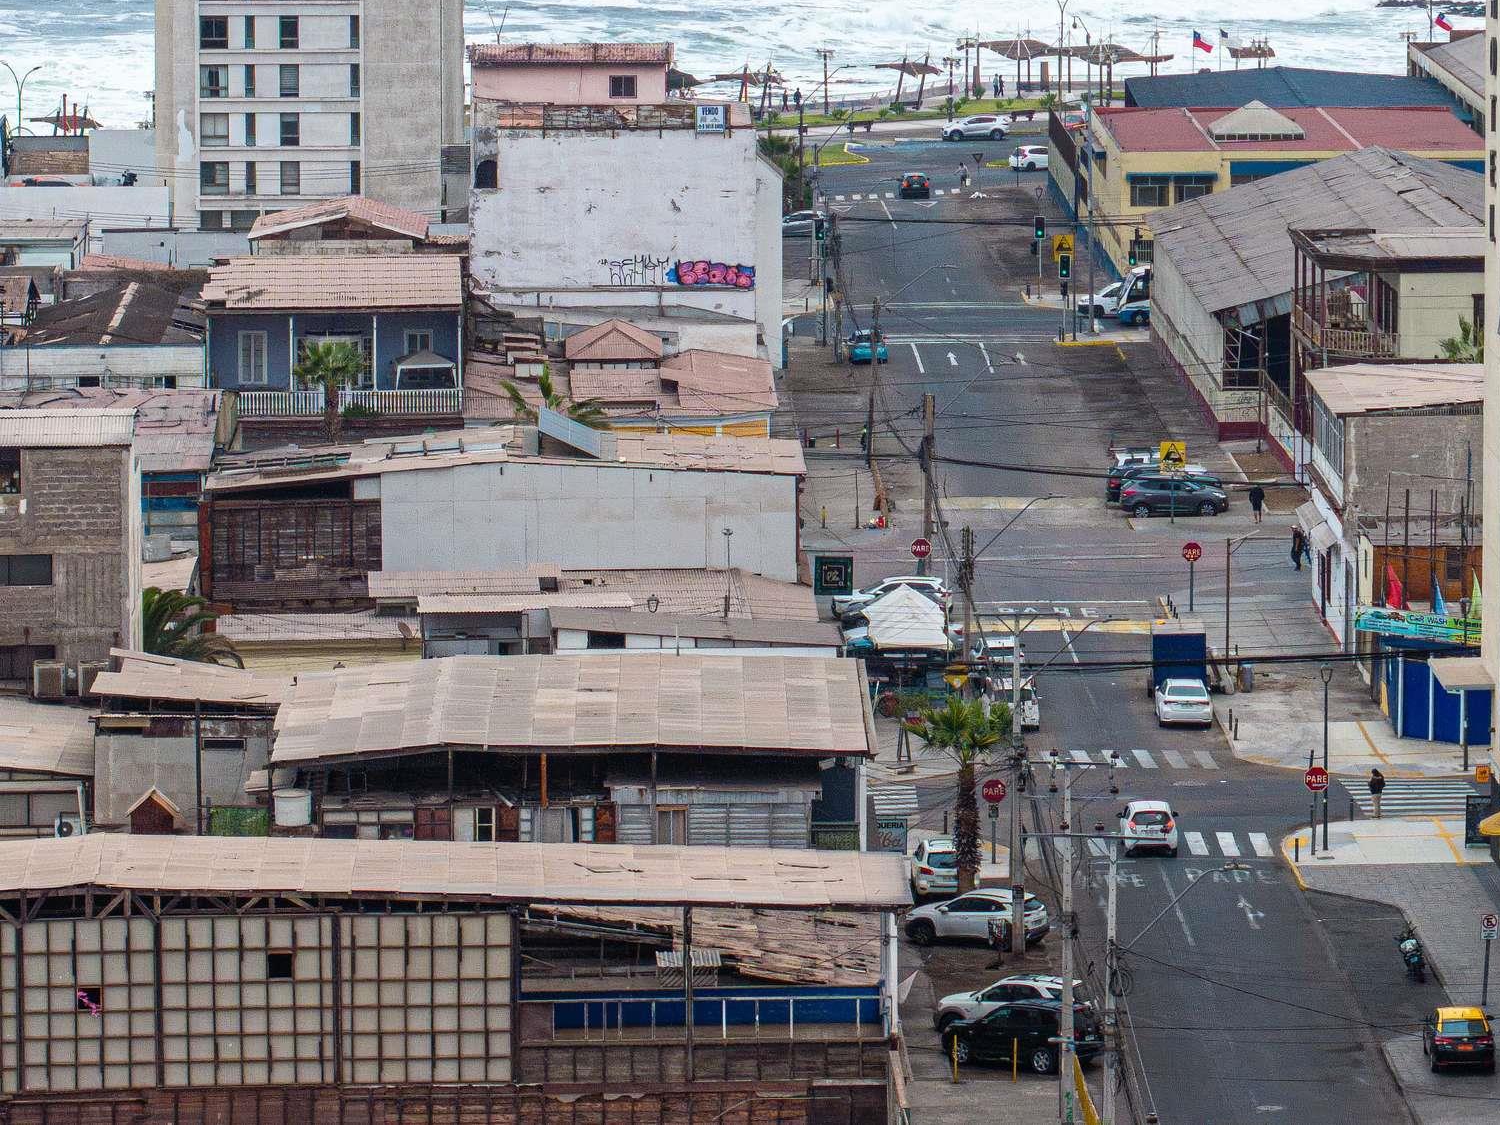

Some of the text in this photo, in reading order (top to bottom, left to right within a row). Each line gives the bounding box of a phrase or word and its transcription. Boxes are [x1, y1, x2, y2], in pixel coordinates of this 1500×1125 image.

[702, 107, 718, 115] VENDO
[1306, 775, 1327, 783] PARE
[983, 787, 1004, 795] PARE
